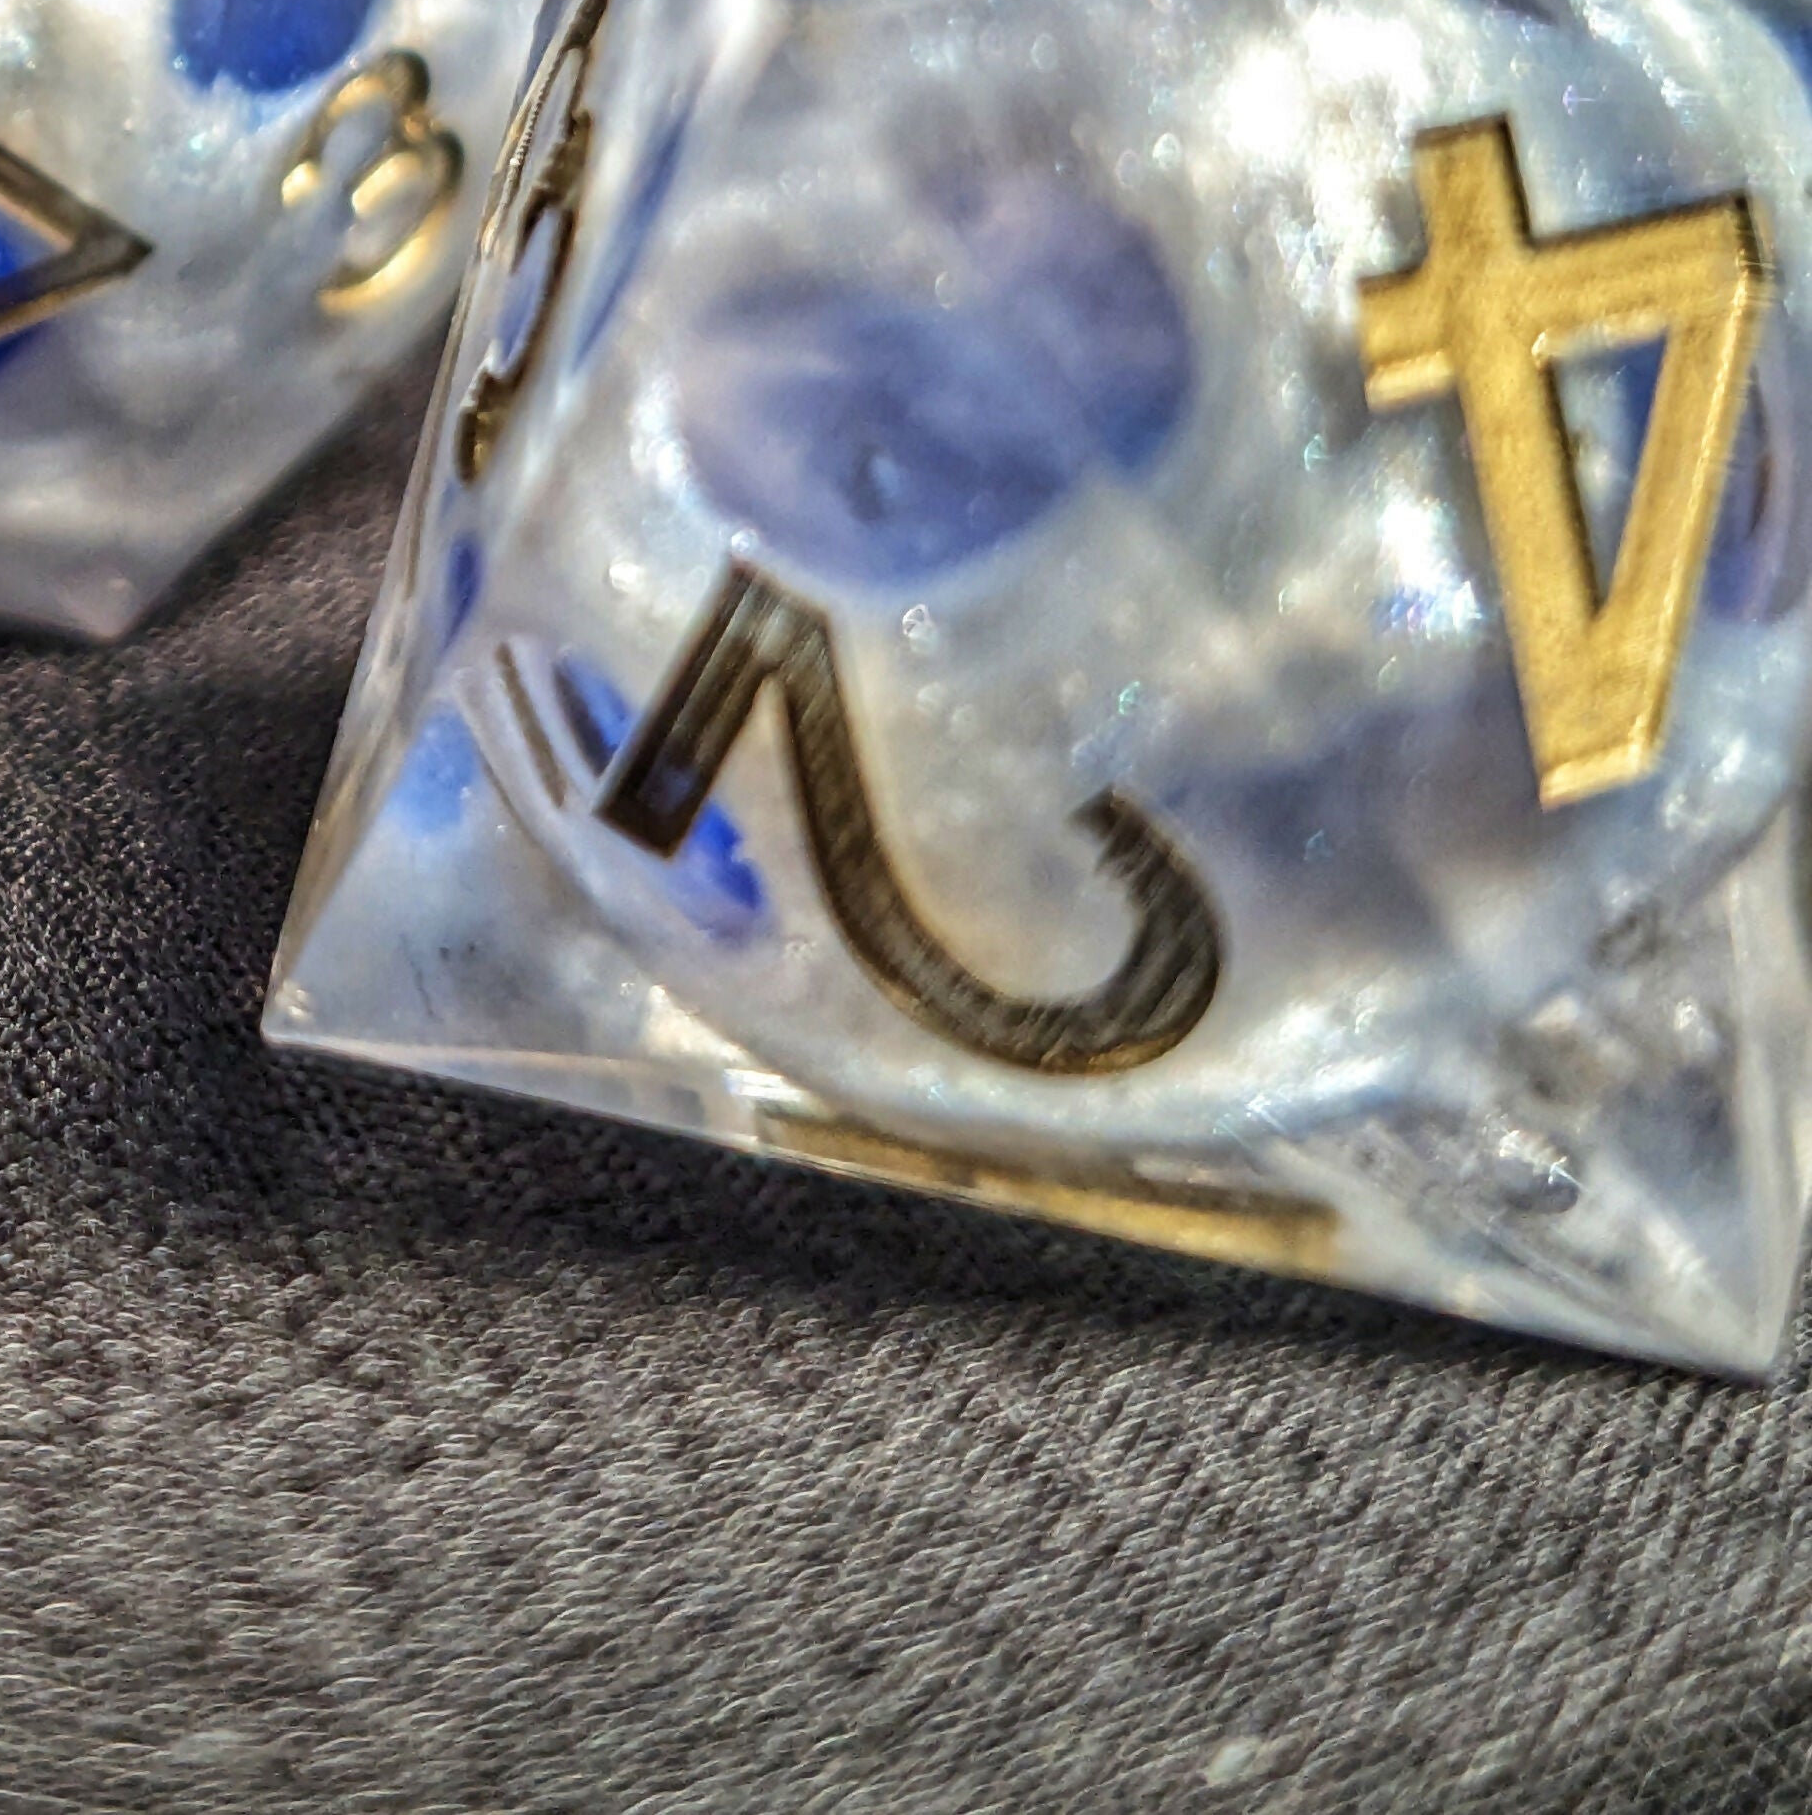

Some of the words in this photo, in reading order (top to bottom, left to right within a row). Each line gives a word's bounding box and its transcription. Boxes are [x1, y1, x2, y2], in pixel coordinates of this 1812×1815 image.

[281, 47, 466, 317] 3
[1358, 112, 1770, 810] 4
[592, 563, 1226, 1075] 2
